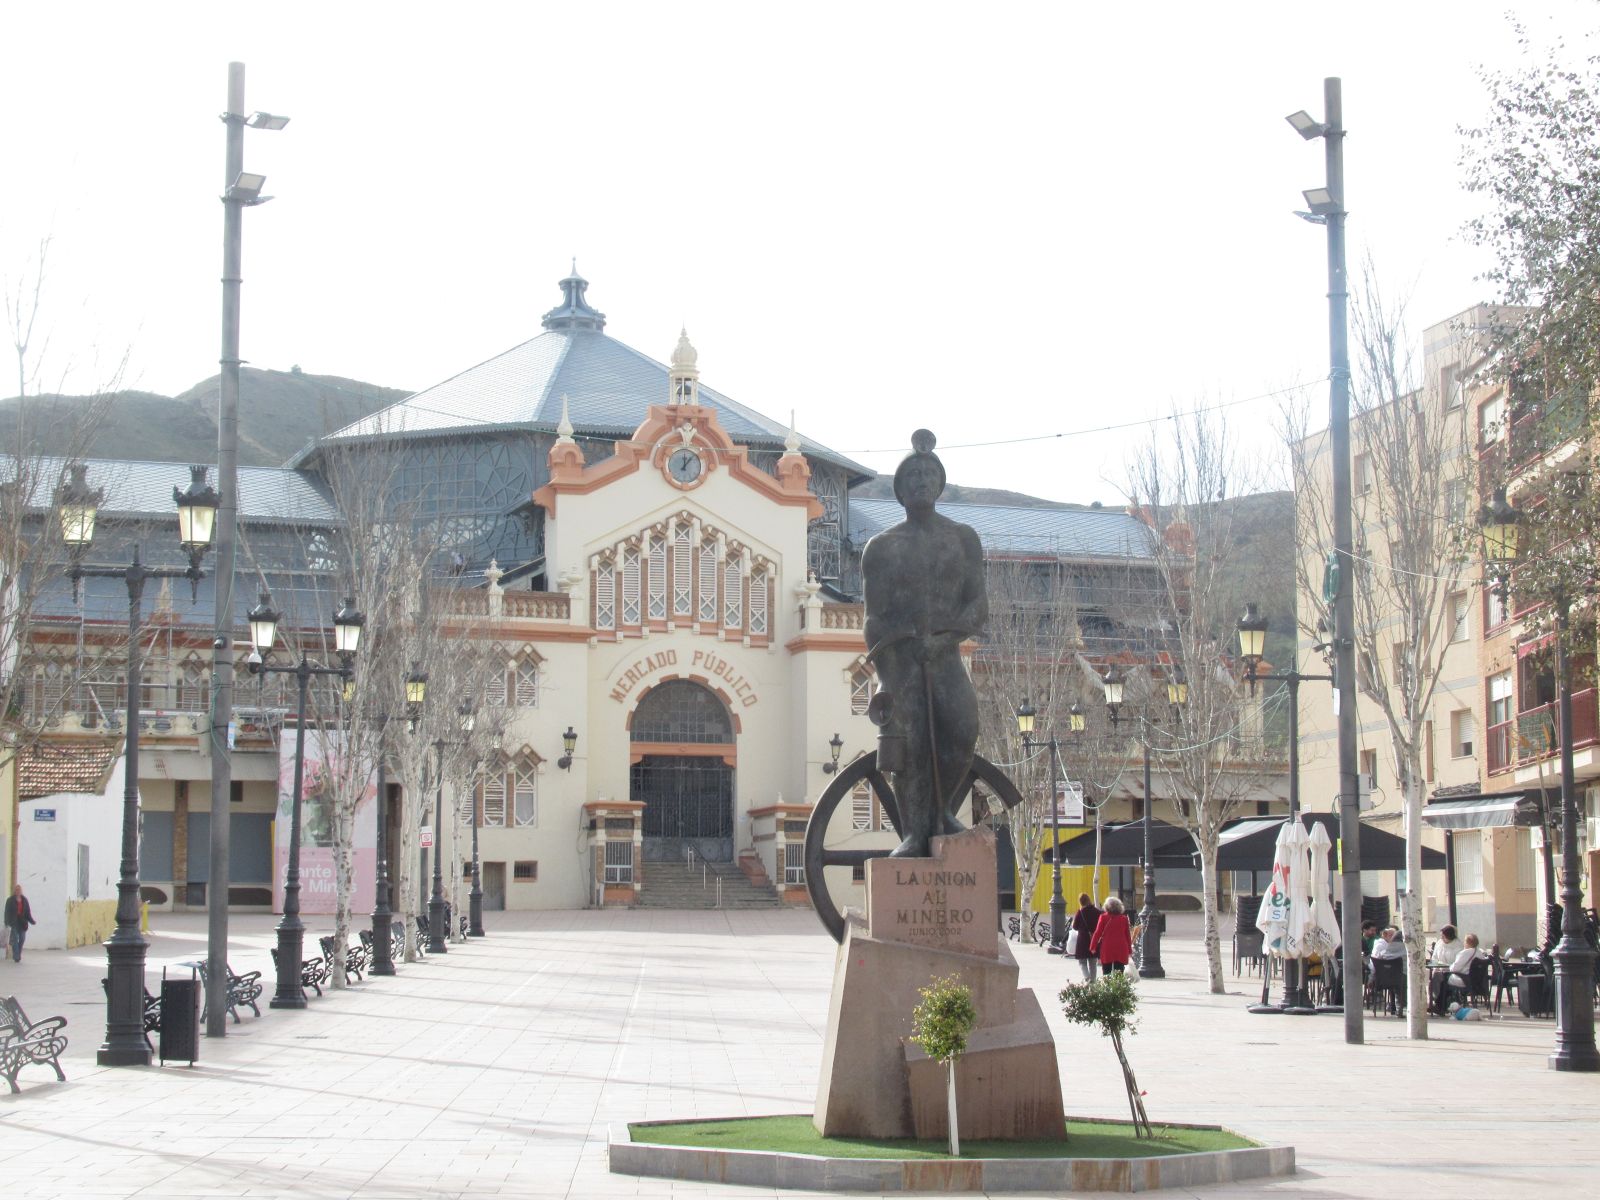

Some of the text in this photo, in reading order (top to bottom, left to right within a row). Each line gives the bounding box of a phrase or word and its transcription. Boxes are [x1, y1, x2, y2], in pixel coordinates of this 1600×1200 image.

[609, 649, 758, 708] MERCADO PÚBLICO
[309, 879, 358, 893] Mins
[895, 871, 919, 886] LA
[922, 890, 948, 905] AL
[896, 909, 974, 925] MINERO
[908, 927, 936, 937] JUNIO
